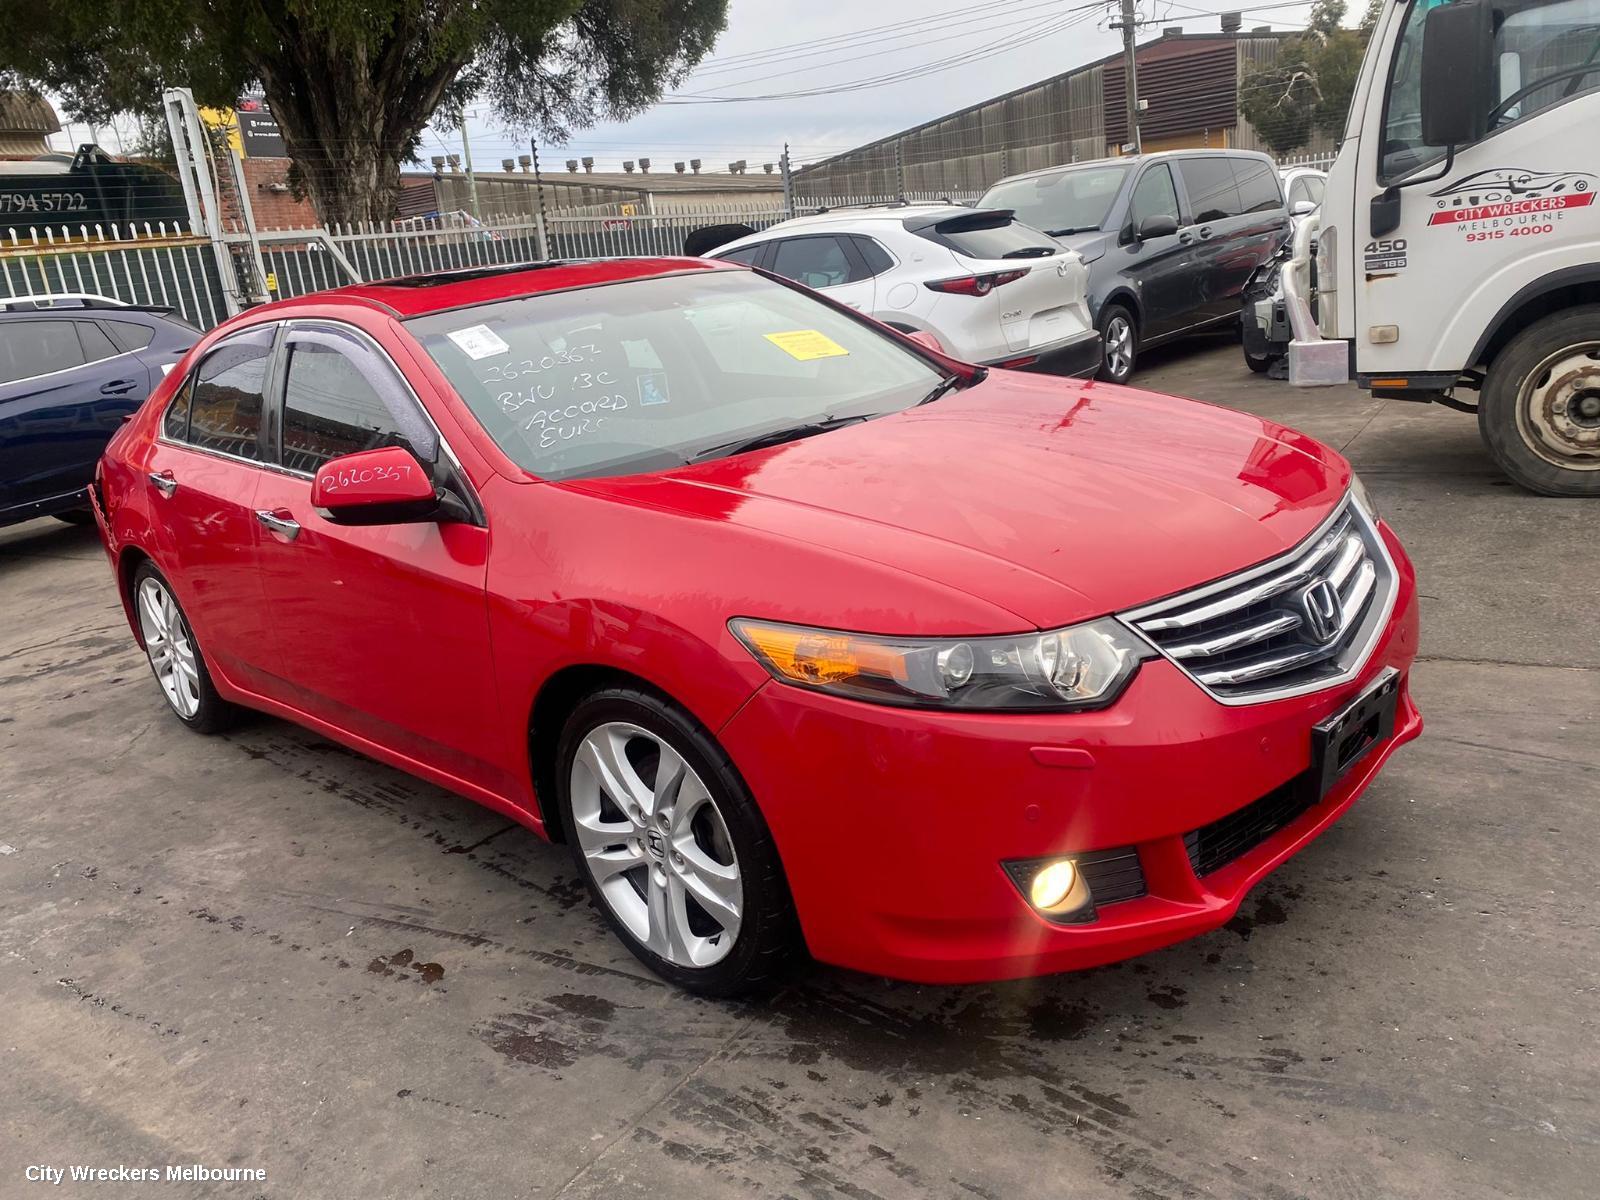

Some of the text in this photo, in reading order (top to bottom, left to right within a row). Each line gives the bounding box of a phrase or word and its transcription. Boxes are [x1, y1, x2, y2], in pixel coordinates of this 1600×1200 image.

[41, 193, 88, 211] 5722
[1454, 197, 1566, 221] CITY WRECKERS
[1457, 211, 1564, 232] MELBOURNE
[1466, 224, 1553, 242] 9315 4000
[1364, 239, 1407, 253] 450
[1384, 259, 1406, 268] 185
[525, 394, 628, 430] ACCORD
